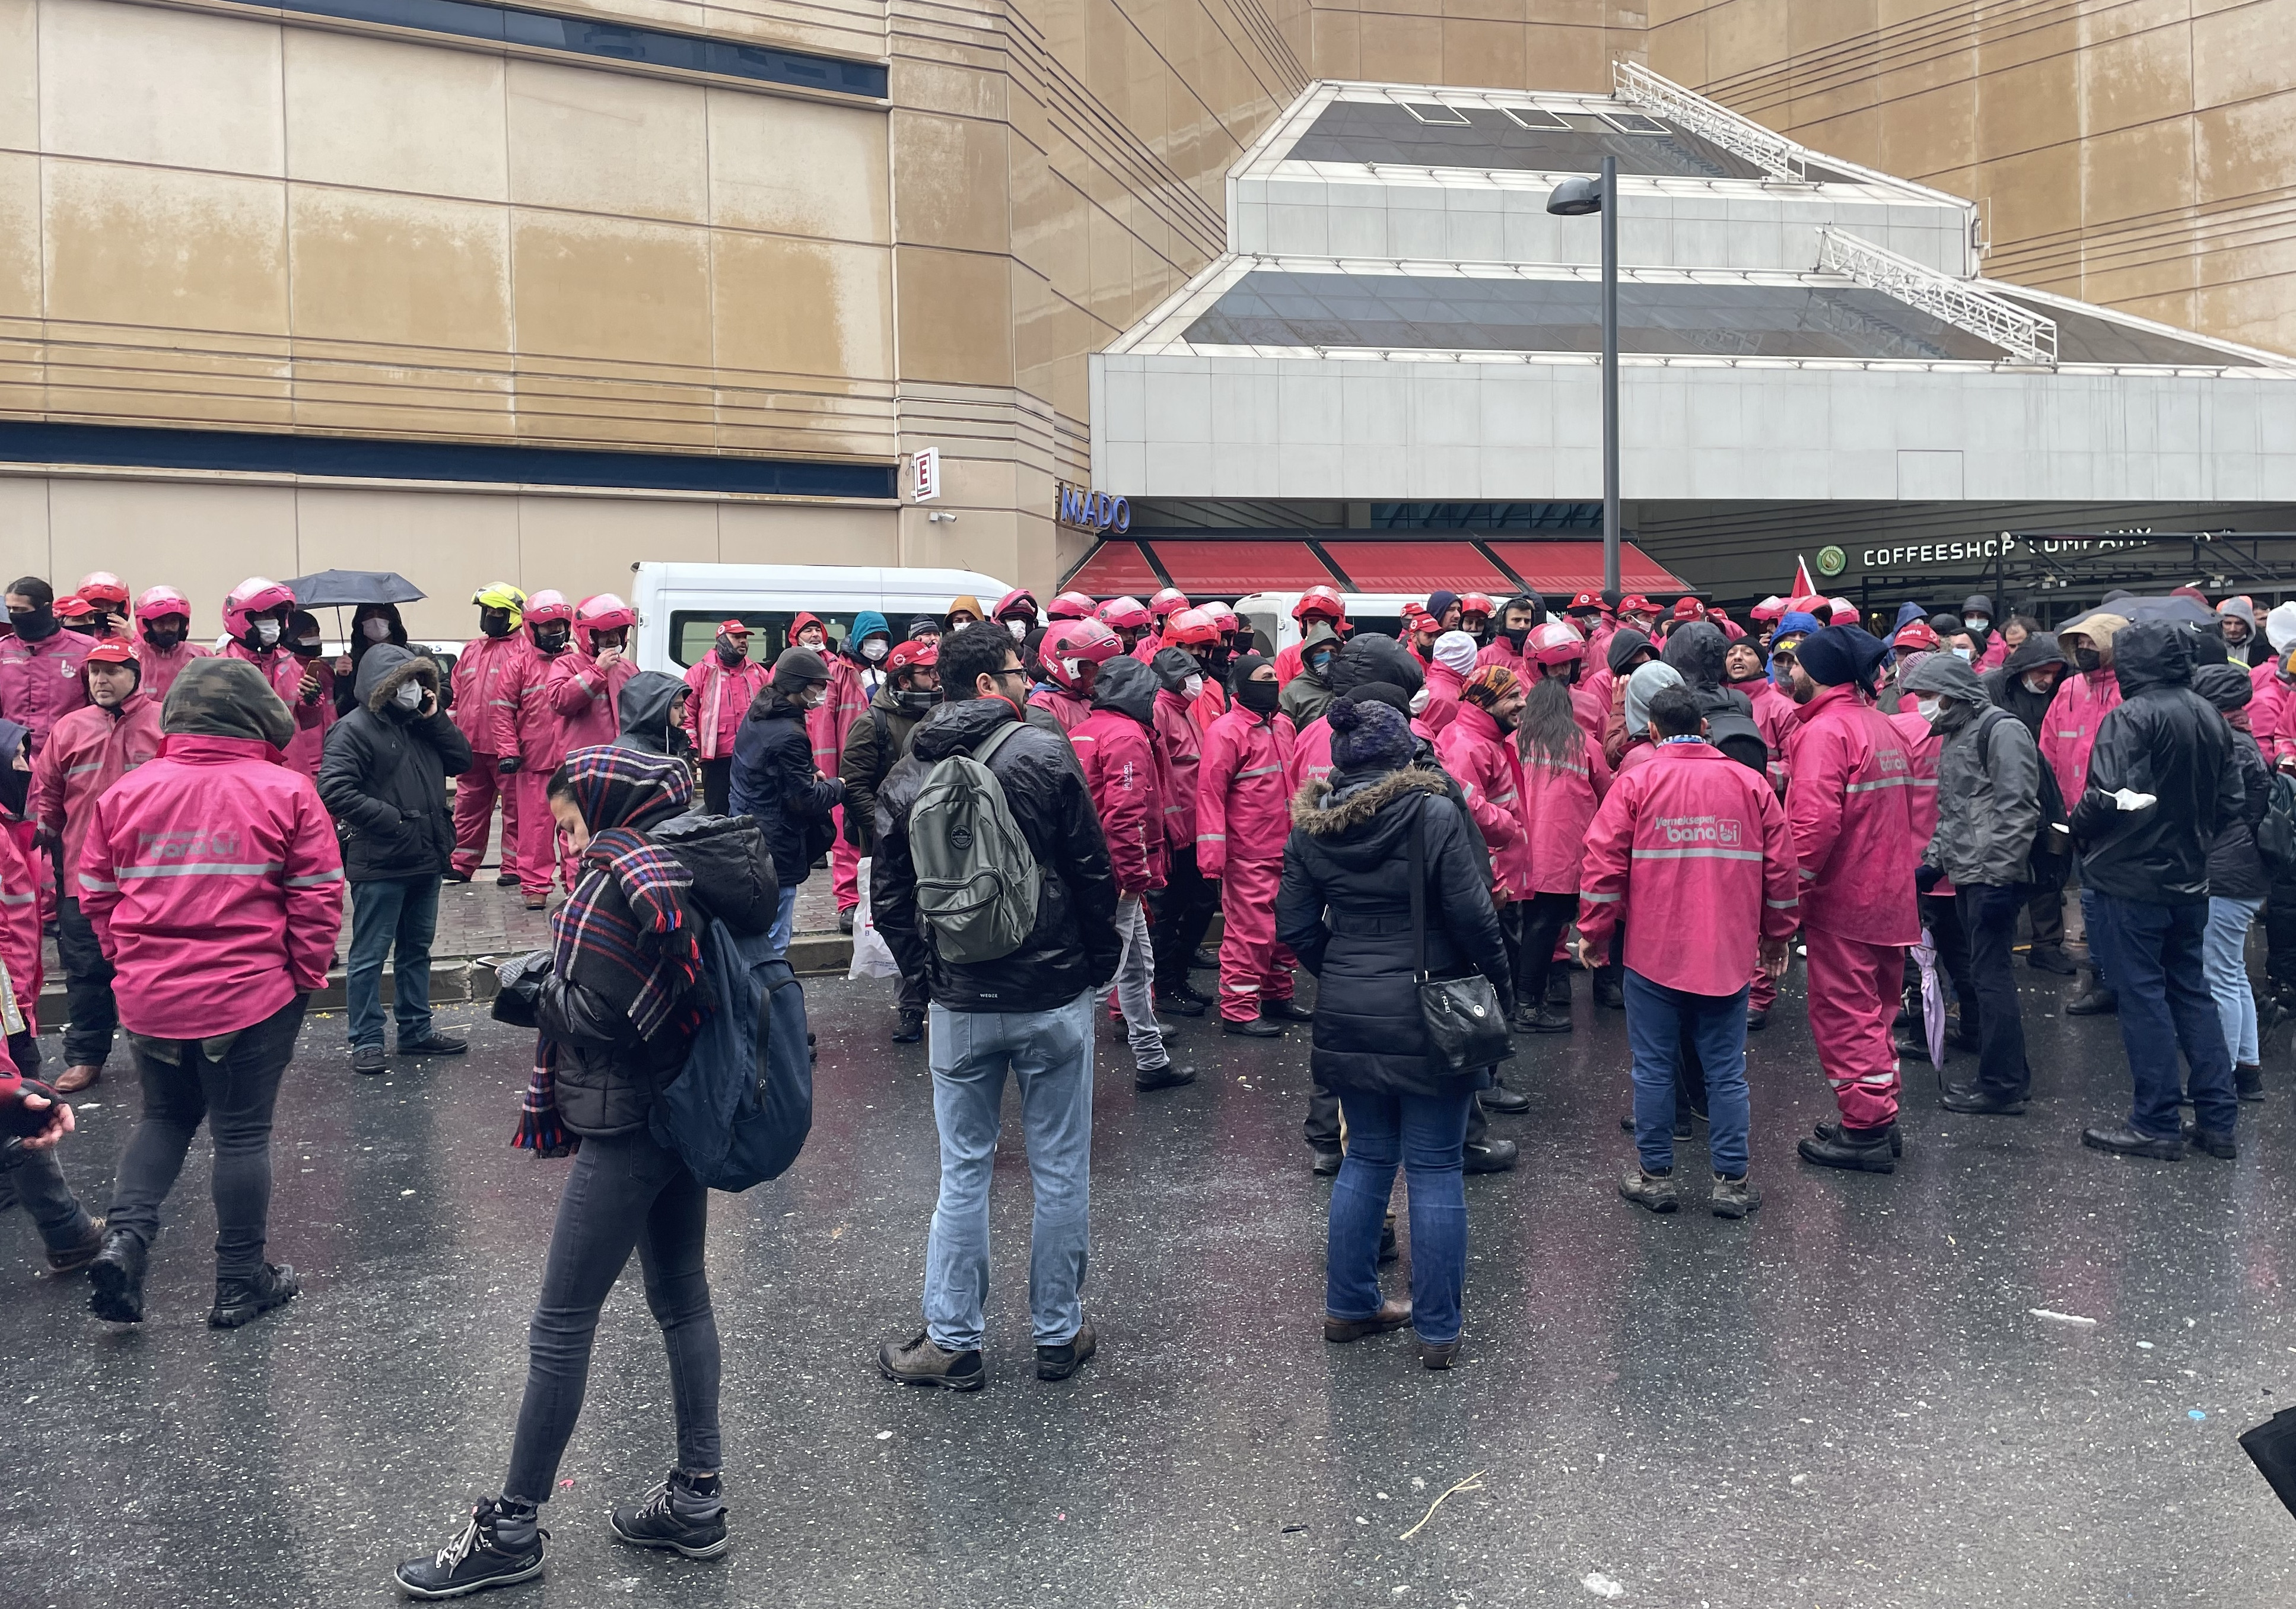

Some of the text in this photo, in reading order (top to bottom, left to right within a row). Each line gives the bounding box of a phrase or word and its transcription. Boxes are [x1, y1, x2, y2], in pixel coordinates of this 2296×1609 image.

[920, 459, 928, 485] E
[1061, 482, 1130, 533] MADO
[1864, 539, 2015, 566] COFFEESHOP
[1779, 641, 1796, 650] W
